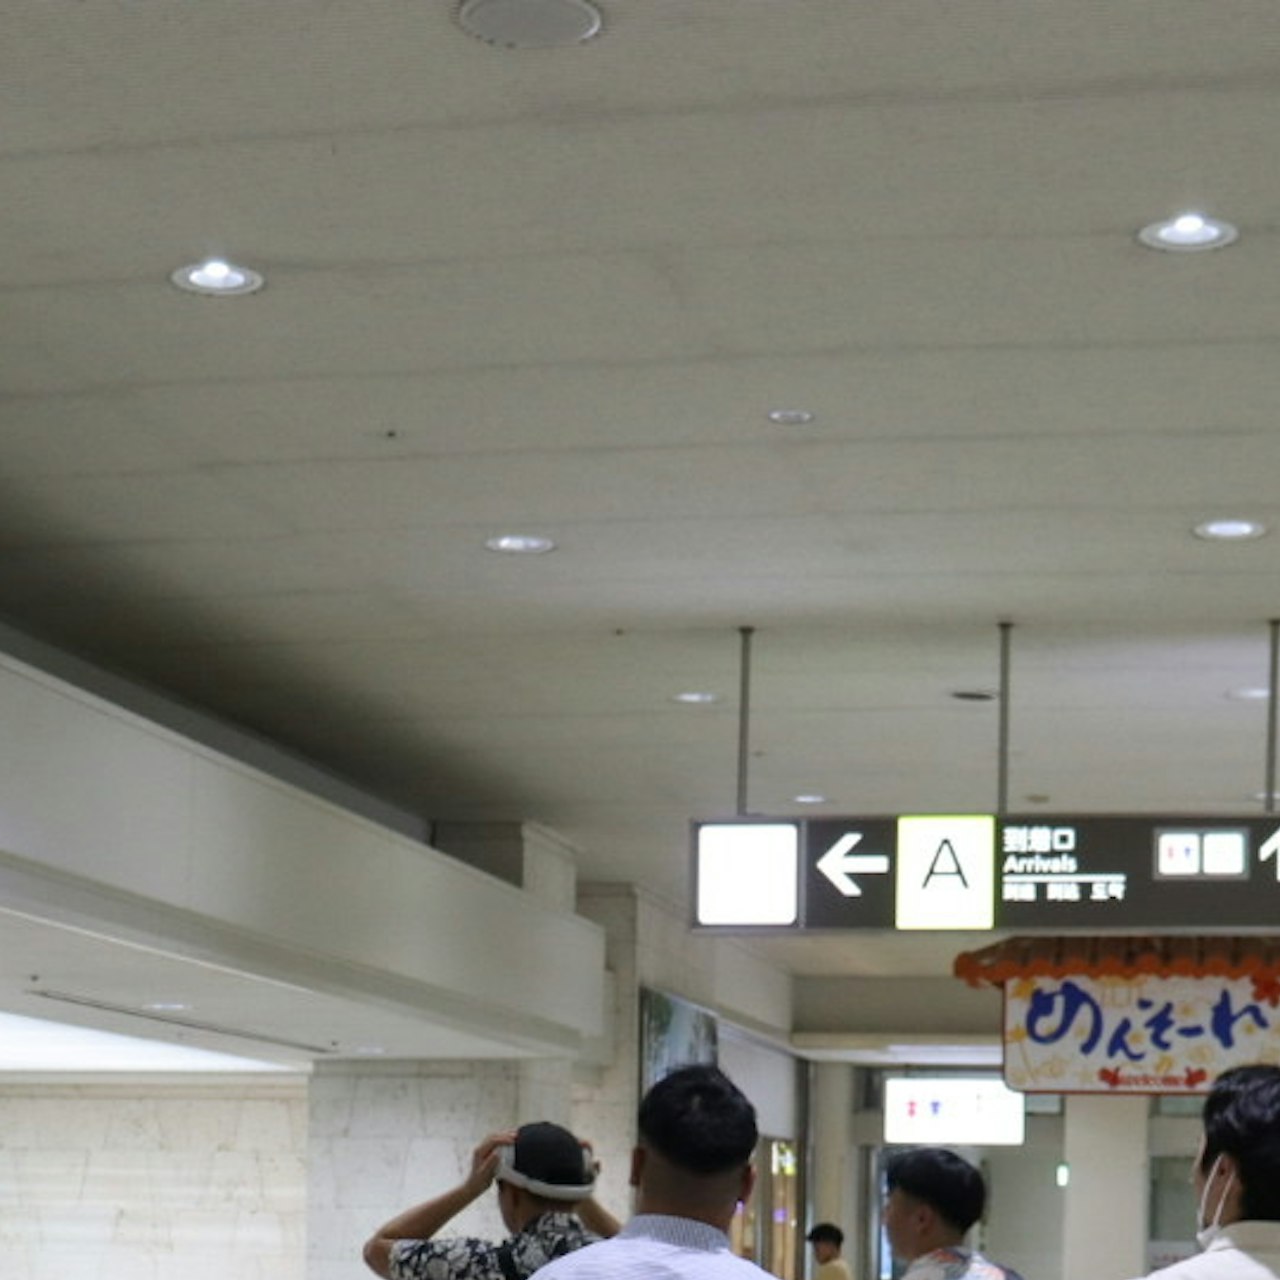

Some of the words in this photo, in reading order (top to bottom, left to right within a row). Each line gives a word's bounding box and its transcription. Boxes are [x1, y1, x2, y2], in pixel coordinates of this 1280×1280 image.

[922, 838, 969, 889] A
[1003, 854, 1078, 873] Arrivals
[1026, 981, 1269, 1062] めんそーれ
